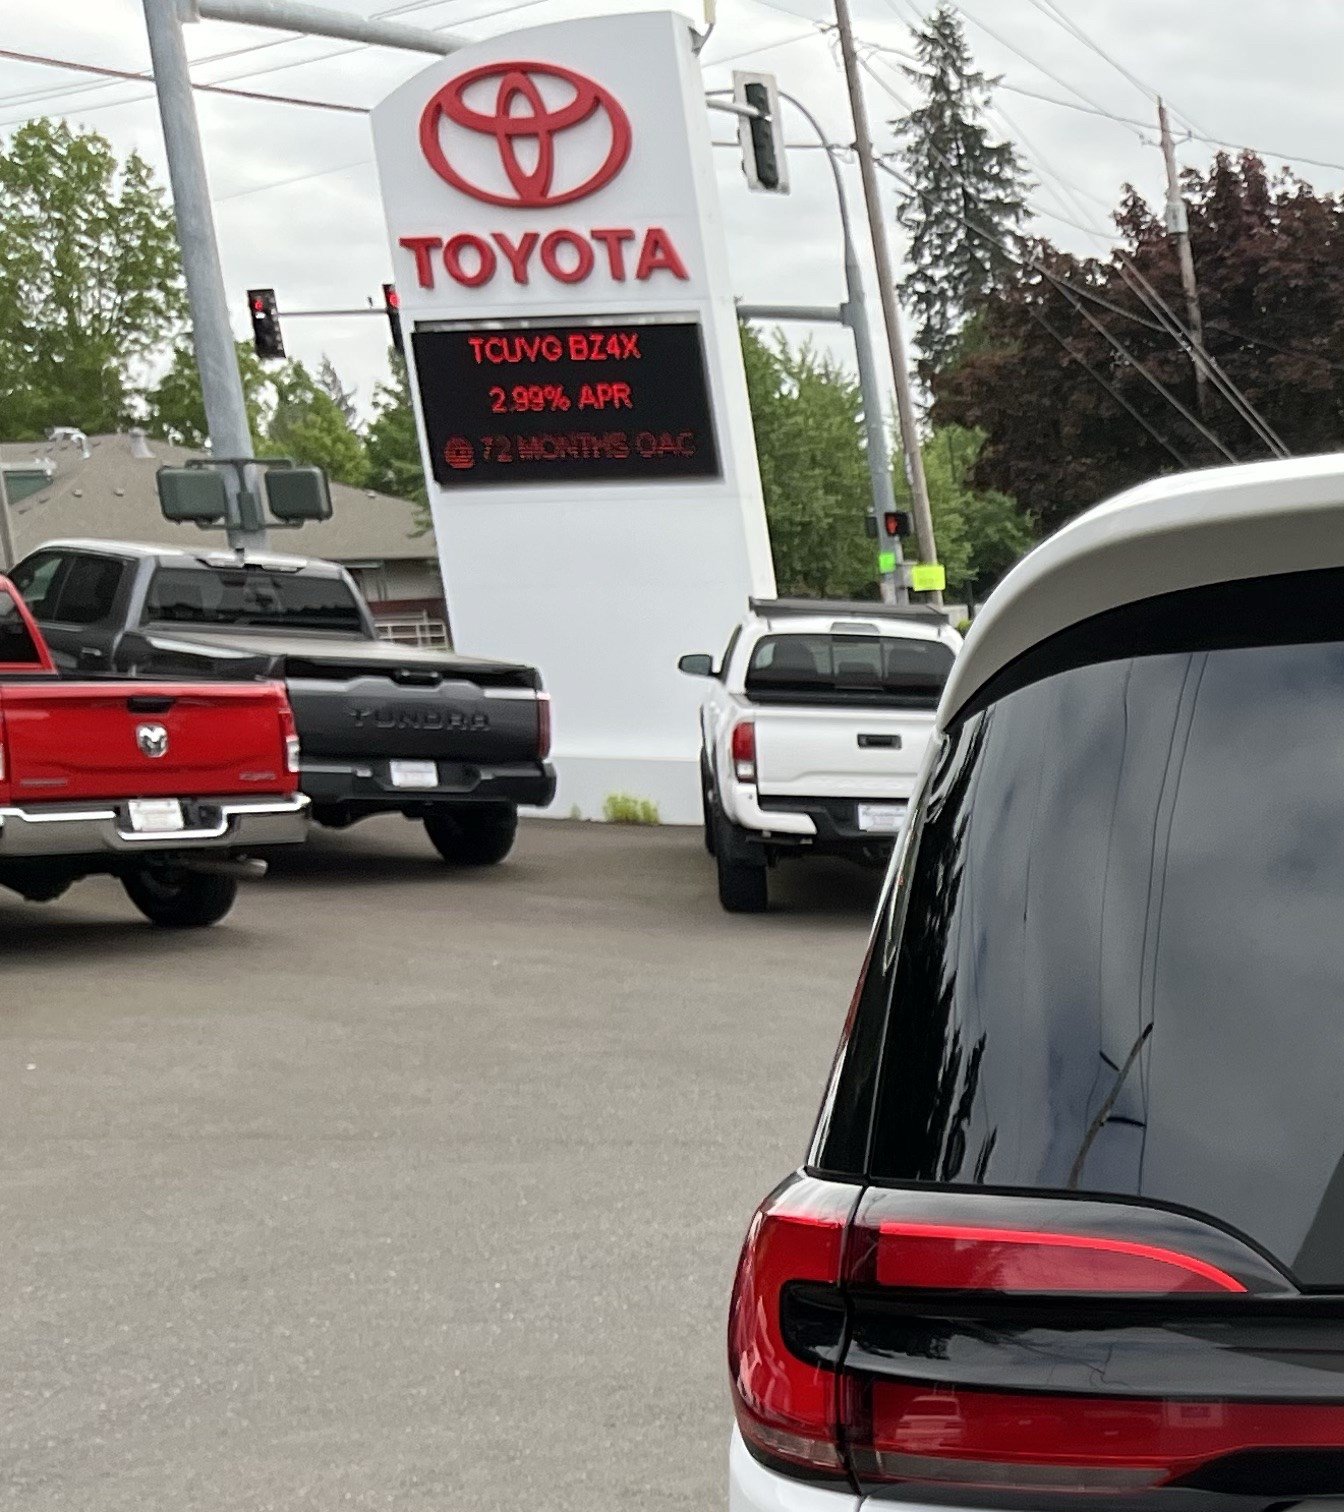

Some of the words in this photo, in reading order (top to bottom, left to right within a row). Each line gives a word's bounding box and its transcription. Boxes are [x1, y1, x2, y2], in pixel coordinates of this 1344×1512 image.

[398, 226, 690, 290] TOYOTA
[567, 331, 642, 361] BZ4X
[488, 384, 571, 414] 2.99%
[578, 380, 633, 411] APR
[349, 708, 491, 731] TUNDRA
